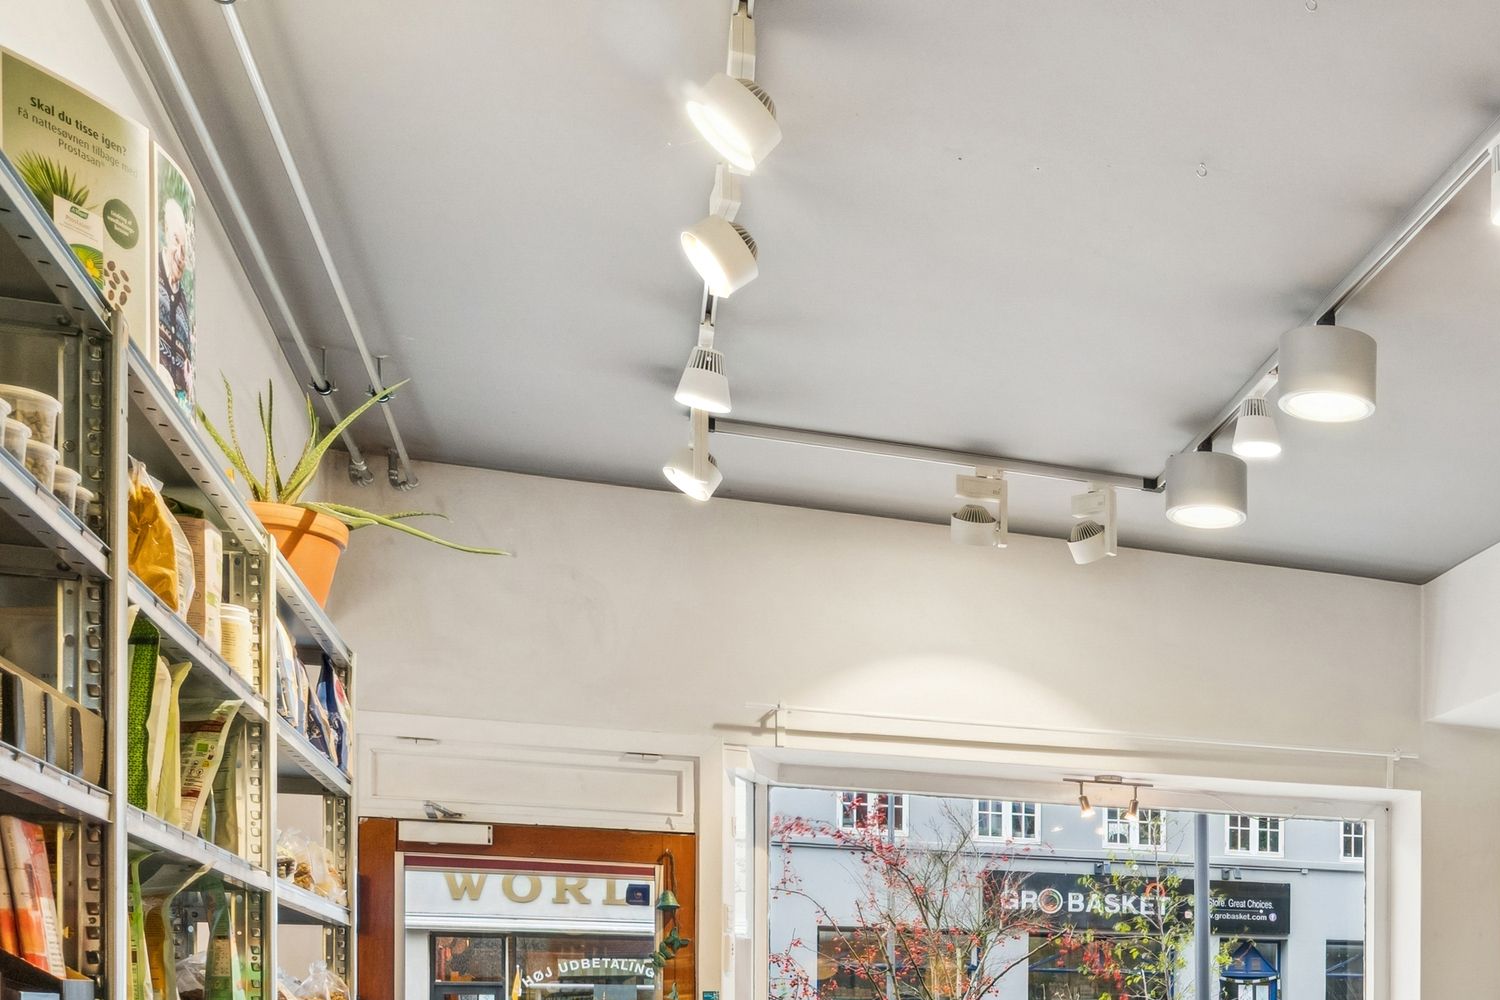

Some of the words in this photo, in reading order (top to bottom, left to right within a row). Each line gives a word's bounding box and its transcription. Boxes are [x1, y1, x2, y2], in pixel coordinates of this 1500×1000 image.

[18, 106, 29, 120] Få
[32, 113, 90, 149] nattesøvnen
[92, 144, 120, 168] tilbage
[30, 96, 55, 116] Skal
[58, 111, 72, 126] du
[75, 119, 99, 140] tisse
[101, 133, 128, 156] igen?
[1067, 892, 1171, 916] BASKET
[1228, 898, 1246, 910] Great
[1247, 898, 1274, 910] Choices.
[521, 966, 553, 988] HØJ
[557, 957, 655, 979] UDBETALING
